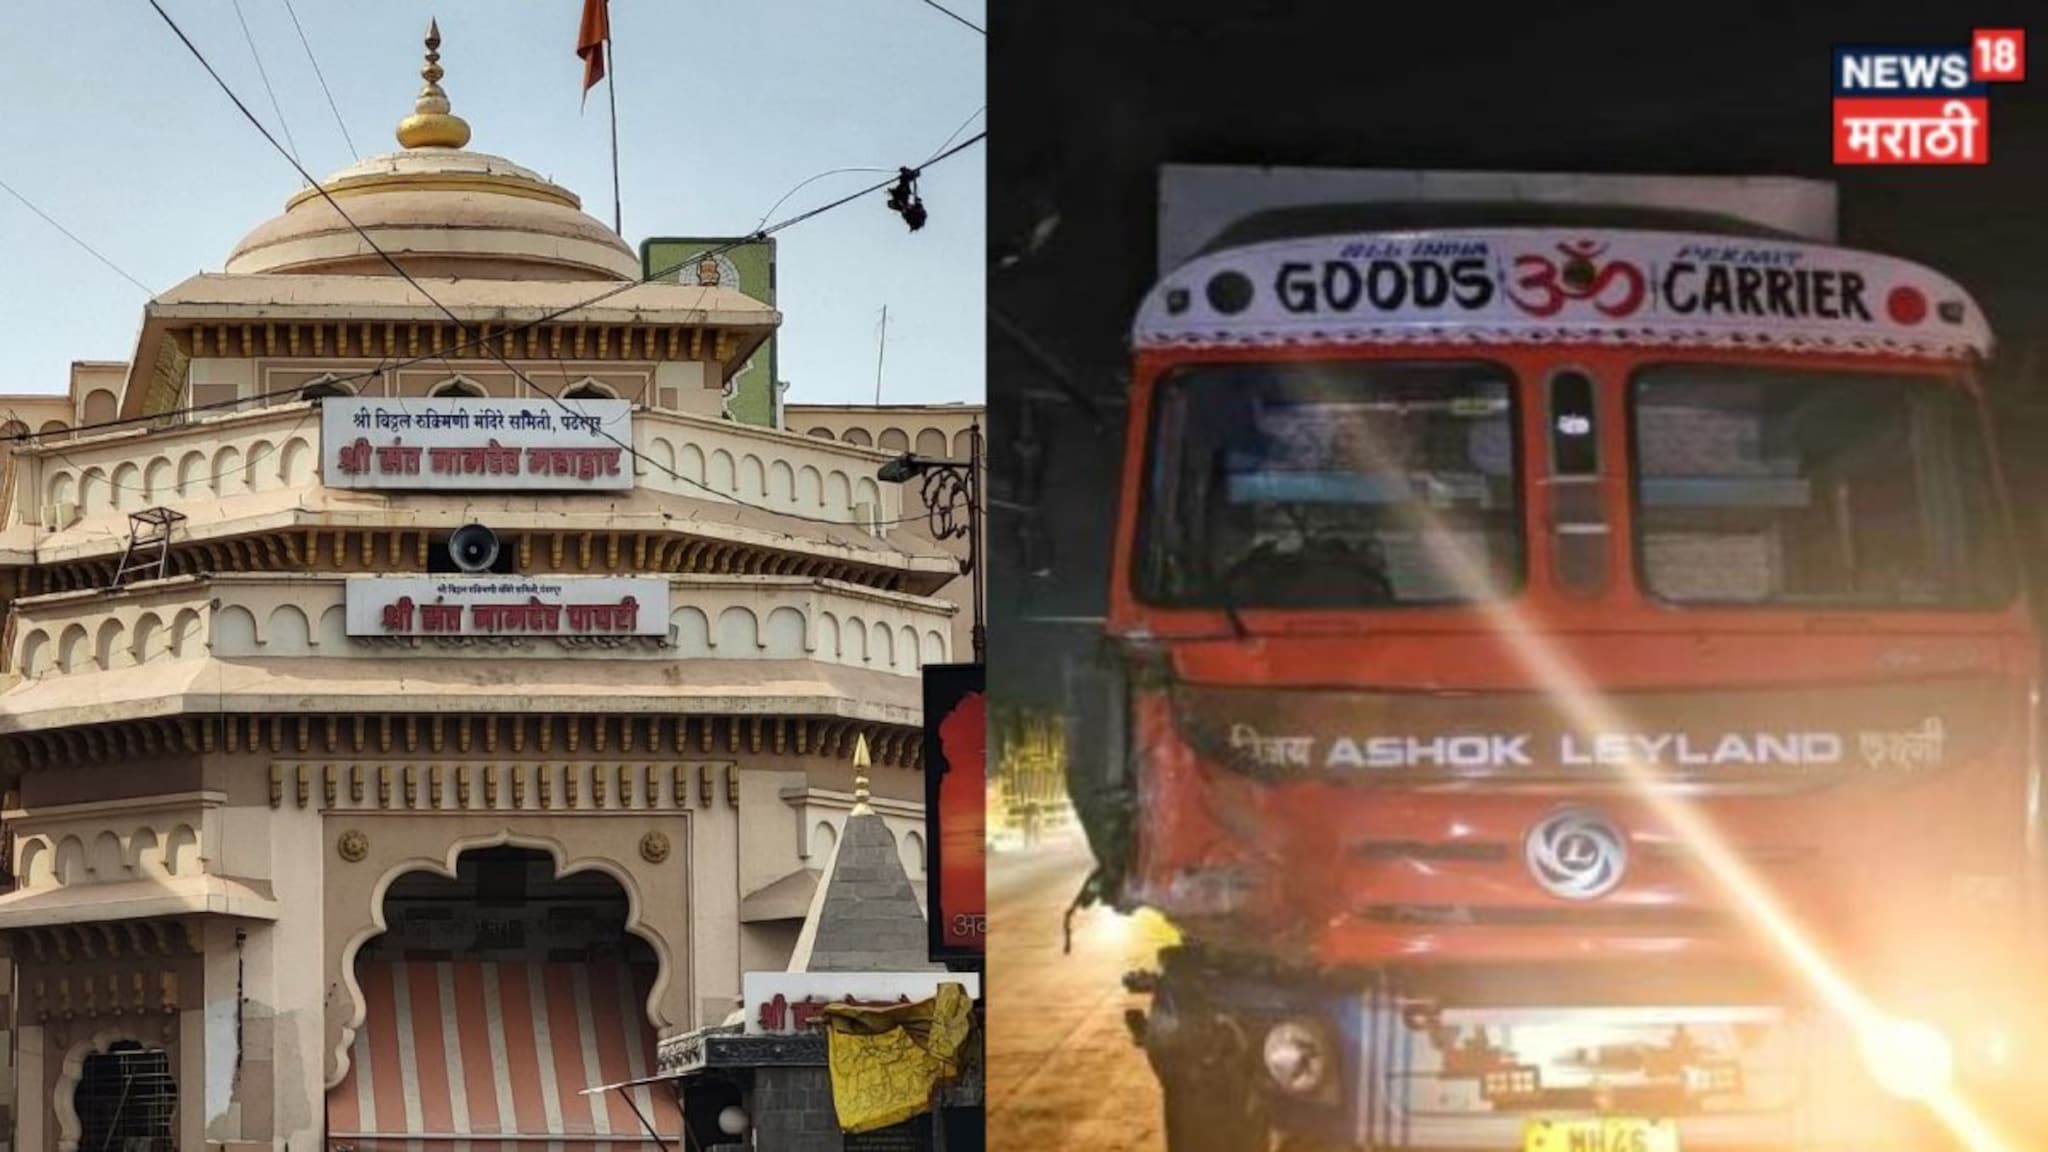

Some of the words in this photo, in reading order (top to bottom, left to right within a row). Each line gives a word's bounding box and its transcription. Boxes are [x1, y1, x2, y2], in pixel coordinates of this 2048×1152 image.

[1274, 259, 1494, 313] GOODS
[1663, 262, 1873, 321] CARRIER
[353, 407, 370, 429] श्री
[474, 408, 504, 430] मंदिरे
[338, 437, 372, 474] श्री
[376, 437, 422, 475] संत
[429, 439, 522, 476] नामदेव
[525, 447, 622, 479] महाद्वार
[382, 597, 414, 632] श्री
[420, 596, 464, 631] संत
[471, 597, 562, 632] नामदेव
[1326, 735, 1531, 767] ASHOK
[1561, 732, 1842, 764] LEYLAND
[757, 993, 788, 1031] श्री
